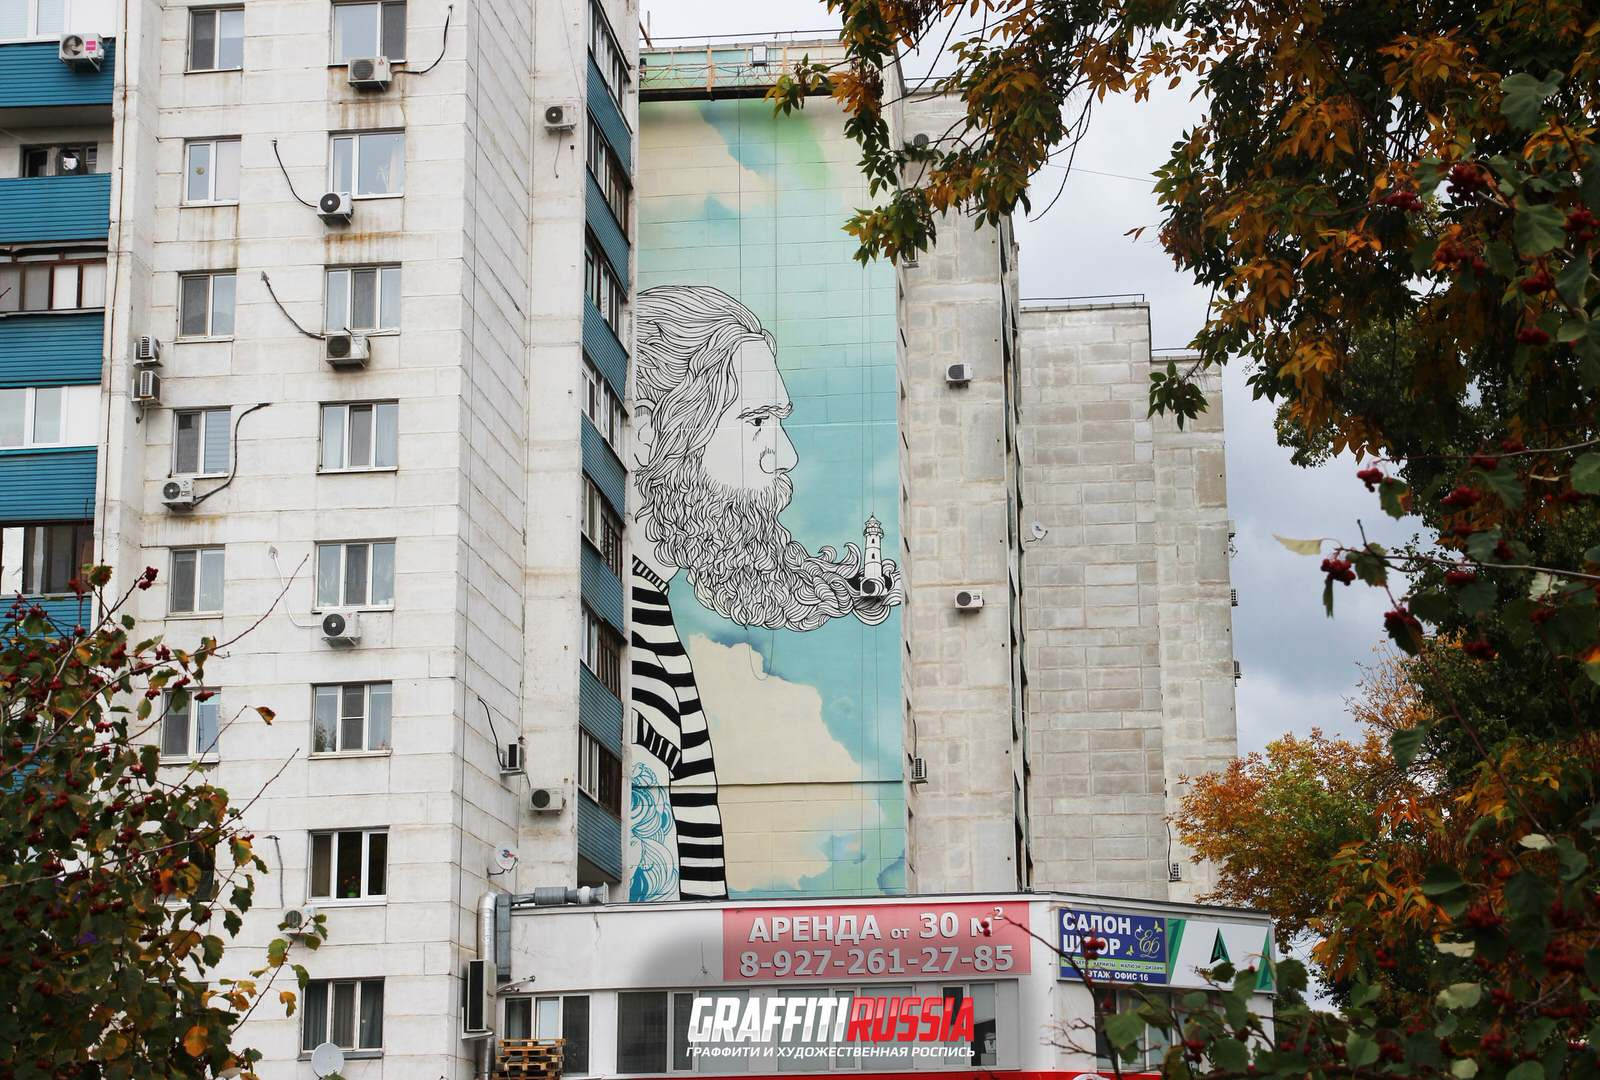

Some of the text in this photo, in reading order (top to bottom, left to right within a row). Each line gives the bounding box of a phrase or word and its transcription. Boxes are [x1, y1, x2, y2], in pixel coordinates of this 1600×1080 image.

[748, 914, 882, 945] АРЕНДА
[890, 928, 910, 939] от
[919, 911, 960, 939] 30
[1062, 911, 1132, 936] САЛОН
[1062, 934, 1121, 956] ШОР
[739, 944, 1014, 977] 8-927-261-27-85
[1114, 971, 1138, 981] ОФИС
[1140, 973, 1149, 982] 16
